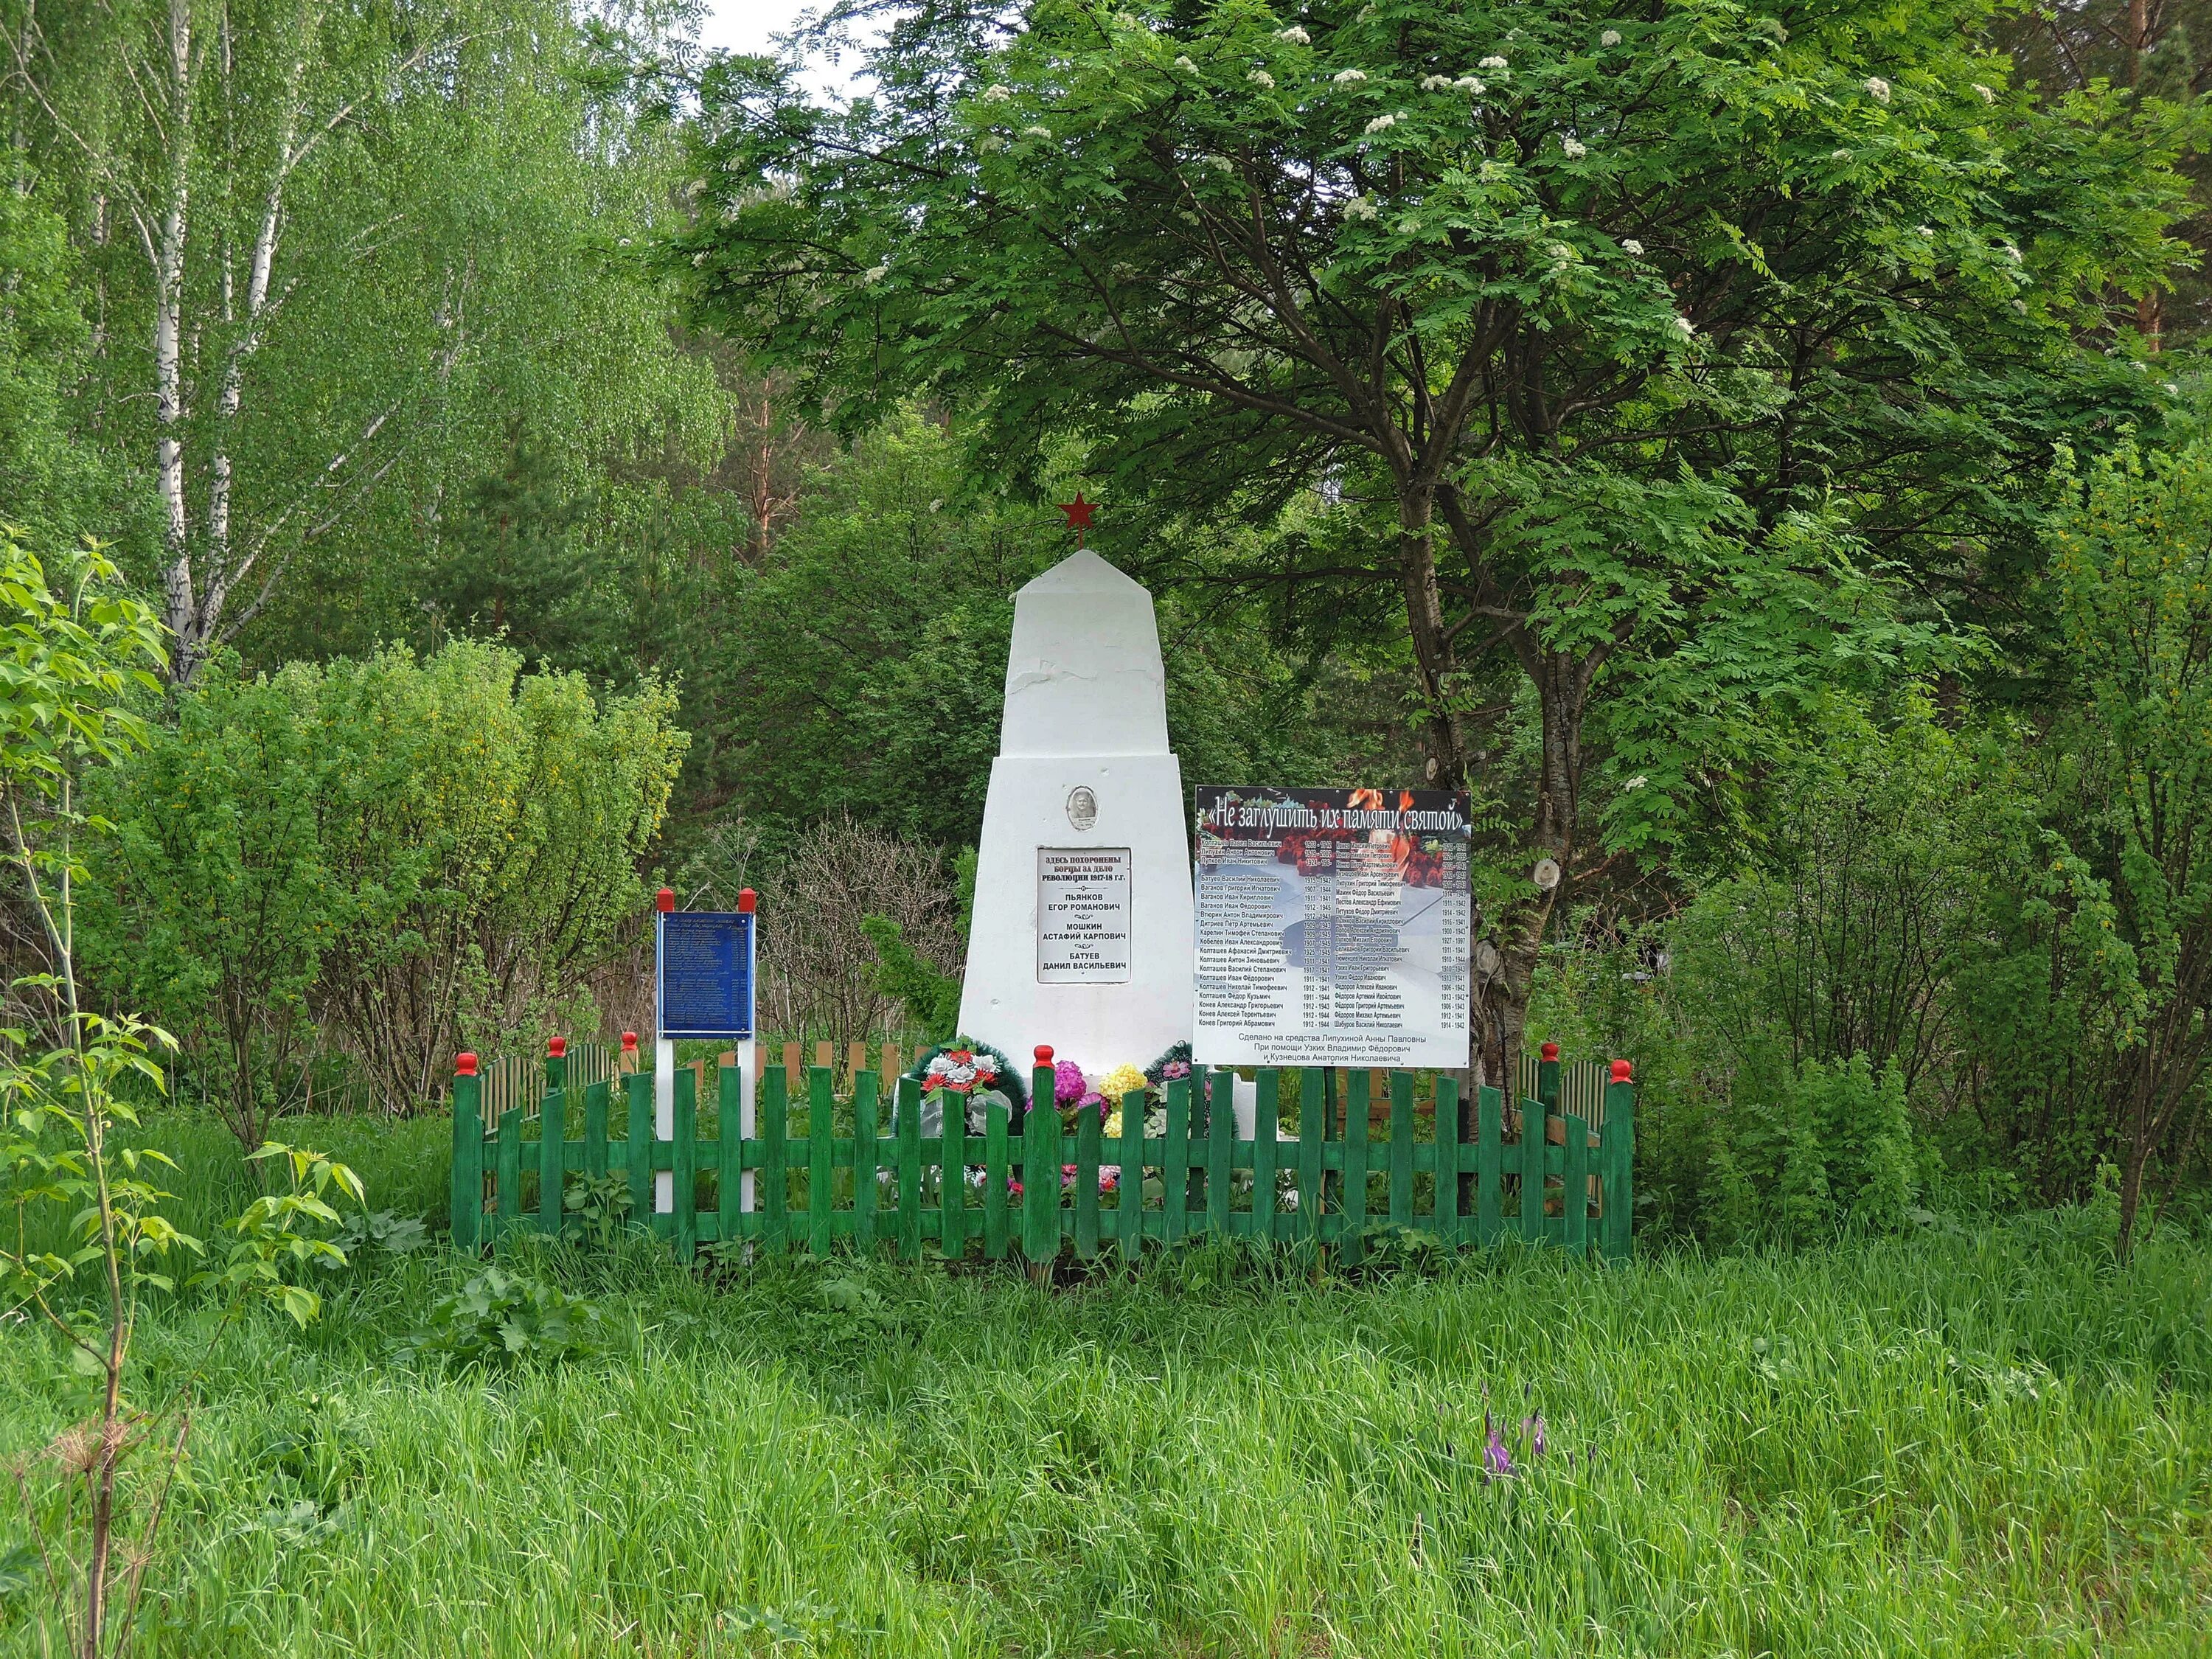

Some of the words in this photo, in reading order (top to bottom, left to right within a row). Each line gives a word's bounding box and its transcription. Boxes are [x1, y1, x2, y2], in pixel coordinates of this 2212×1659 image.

[1208, 796, 1235, 826] «Не
[1239, 807, 1317, 839] заглушить
[1321, 810, 1339, 828] их
[1342, 810, 1400, 829] памяти
[1404, 799, 1463, 830] святой»
[1239, 1033, 1272, 1041] Сделано
[1323, 1034, 1363, 1043] Липухиной
[1254, 1043, 1269, 1051] При
[1327, 1044, 1366, 1053] Владимир
[1368, 1045, 1410, 1054] Фёдорович
[1271, 1053, 1310, 1062] Кузнецова
